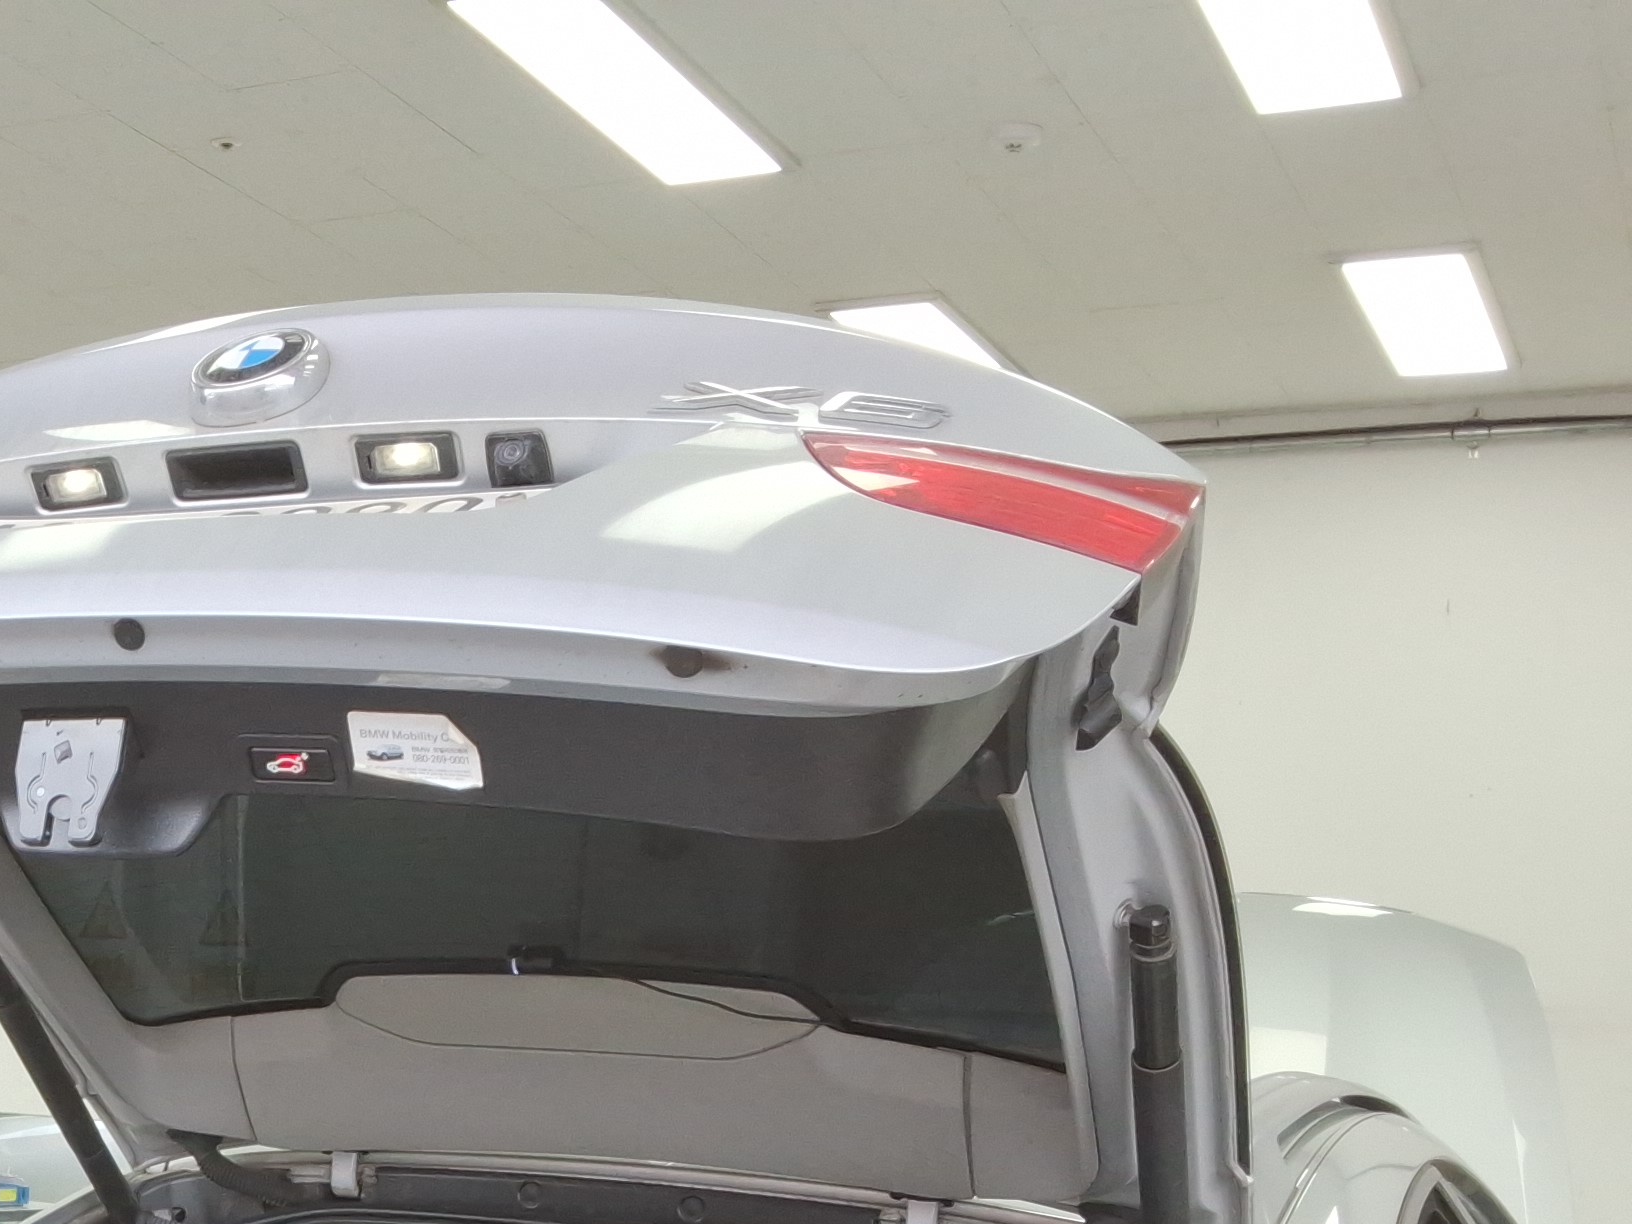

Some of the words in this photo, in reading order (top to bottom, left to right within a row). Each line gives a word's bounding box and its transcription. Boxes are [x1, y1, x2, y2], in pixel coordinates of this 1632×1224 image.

[649, 380, 954, 430] X6
[359, 728, 390, 740] BMW
[392, 729, 439, 743] Mobility
